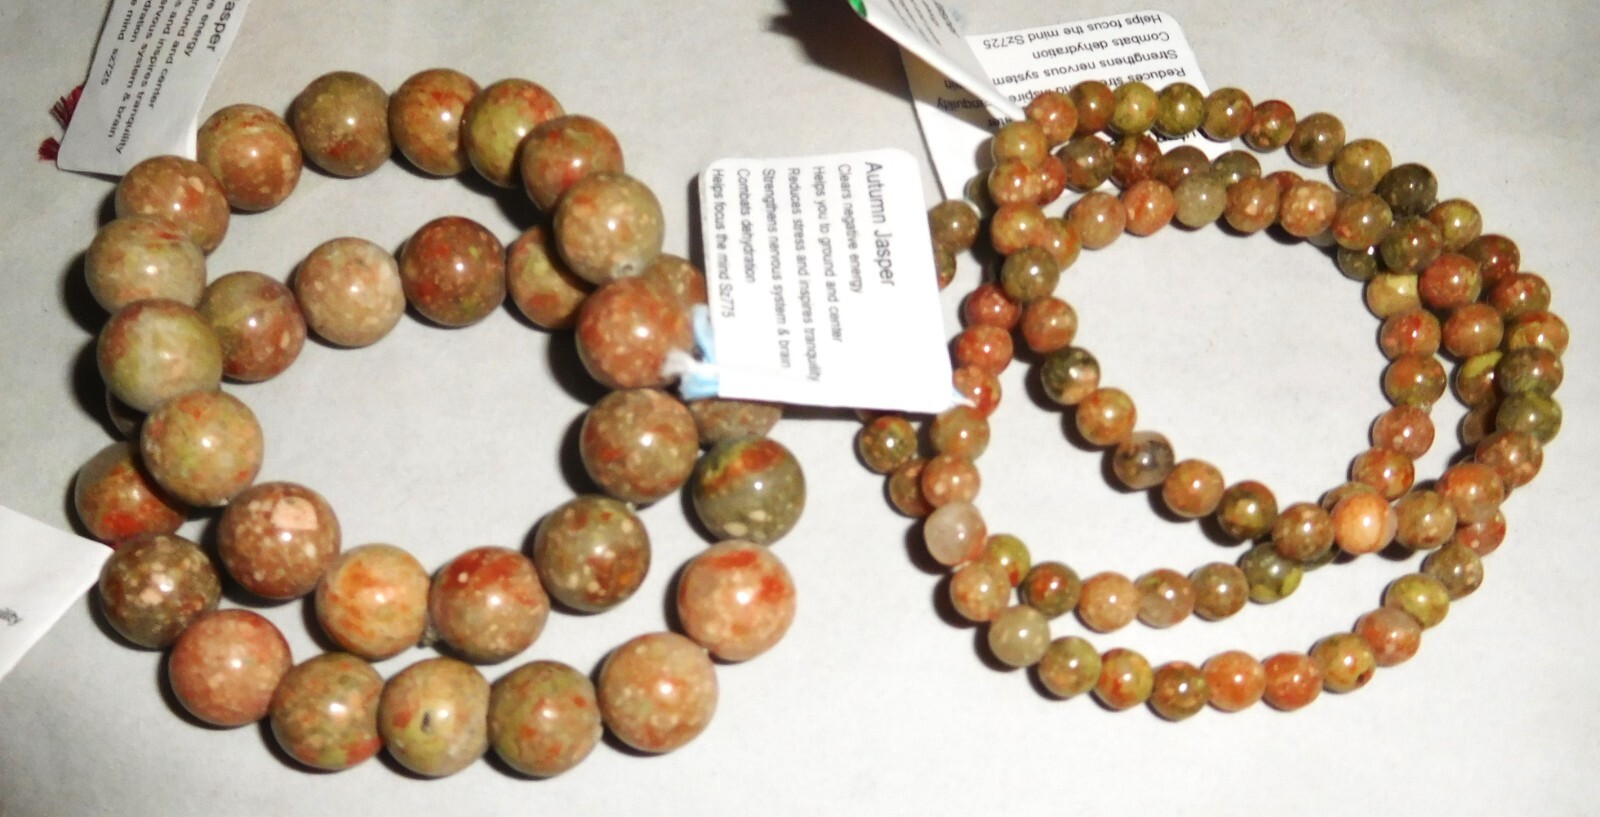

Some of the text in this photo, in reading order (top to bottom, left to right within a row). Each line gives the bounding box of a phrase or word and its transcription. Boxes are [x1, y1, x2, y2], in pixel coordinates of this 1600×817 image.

[177, 0, 199, 37] round
[184, 14, 208, 57] energy
[206, 0, 235, 52] asper
[982, 14, 1162, 50] Helps focus the mind Sz725
[101, 10, 133, 86] mind sz725
[127, 43, 148, 88] system
[166, 41, 180, 64] and
[992, 49, 1178, 87] Strengthens nervous system
[1032, 31, 1170, 60] Combats dehydration
[115, 11, 177, 154] and inspires tranquility
[149, 68, 168, 109] center
[1127, 66, 1186, 82] Reduces
[122, 92, 131, 102] &
[108, 106, 127, 138] brain
[710, 168, 735, 318] Helps focus the mind Sz775
[737, 168, 756, 283] Combats dehydration
[837, 163, 863, 294] Clears negative energy
[866, 161, 895, 286] Autumn Jasper
[762, 168, 791, 368] Strengthens nervous system & brain
[788, 167, 822, 382] Reduces stress and inspires tranquility
[813, 166, 843, 342] Helps you to ground and center
